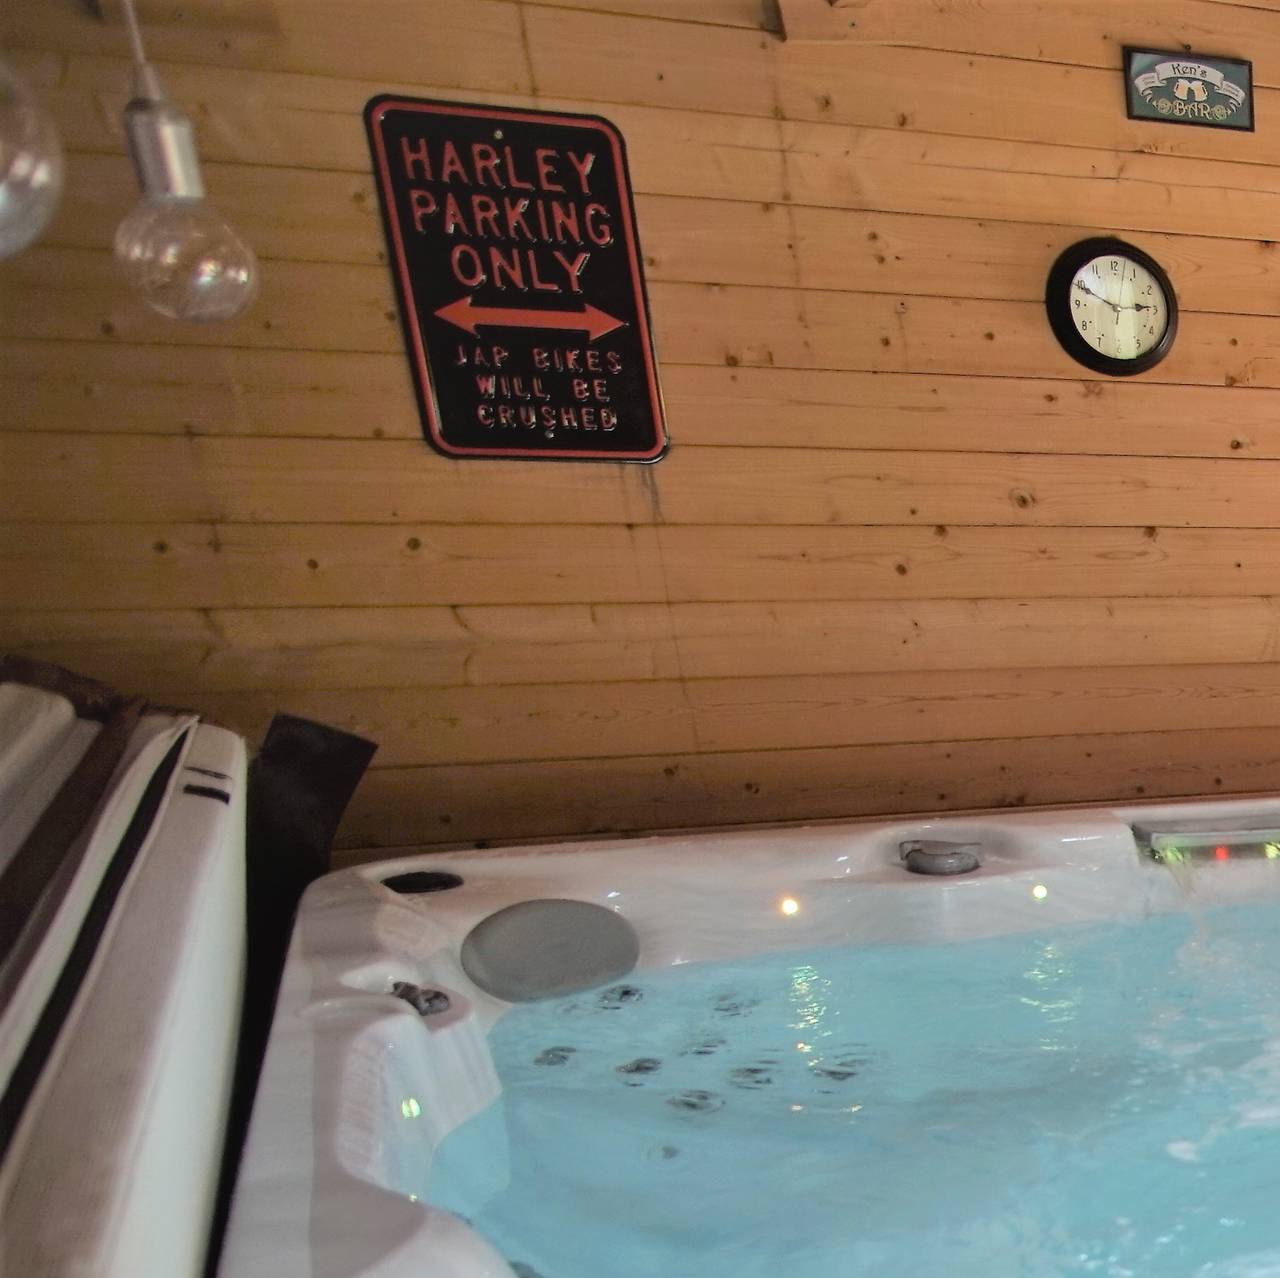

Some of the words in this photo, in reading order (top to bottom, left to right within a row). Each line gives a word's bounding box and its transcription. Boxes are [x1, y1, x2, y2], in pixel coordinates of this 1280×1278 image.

[1172, 63, 1207, 78] Ken's
[1173, 100, 1213, 120] BAR
[401, 136, 596, 196] HARLEY
[407, 189, 615, 248] PARKING
[450, 244, 591, 294] ONLY
[1110, 261, 1118, 271] 12
[1147, 285, 1152, 295] 2
[1075, 300, 1080, 309] 9
[1081, 320, 1087, 331] 8
[1096, 337, 1102, 347] 7
[455, 345, 510, 369] JAP
[532, 347, 622, 375] BIKES
[475, 374, 551, 400] WILL
[572, 378, 611, 401] BE
[476, 405, 619, 431] CRUSHED
